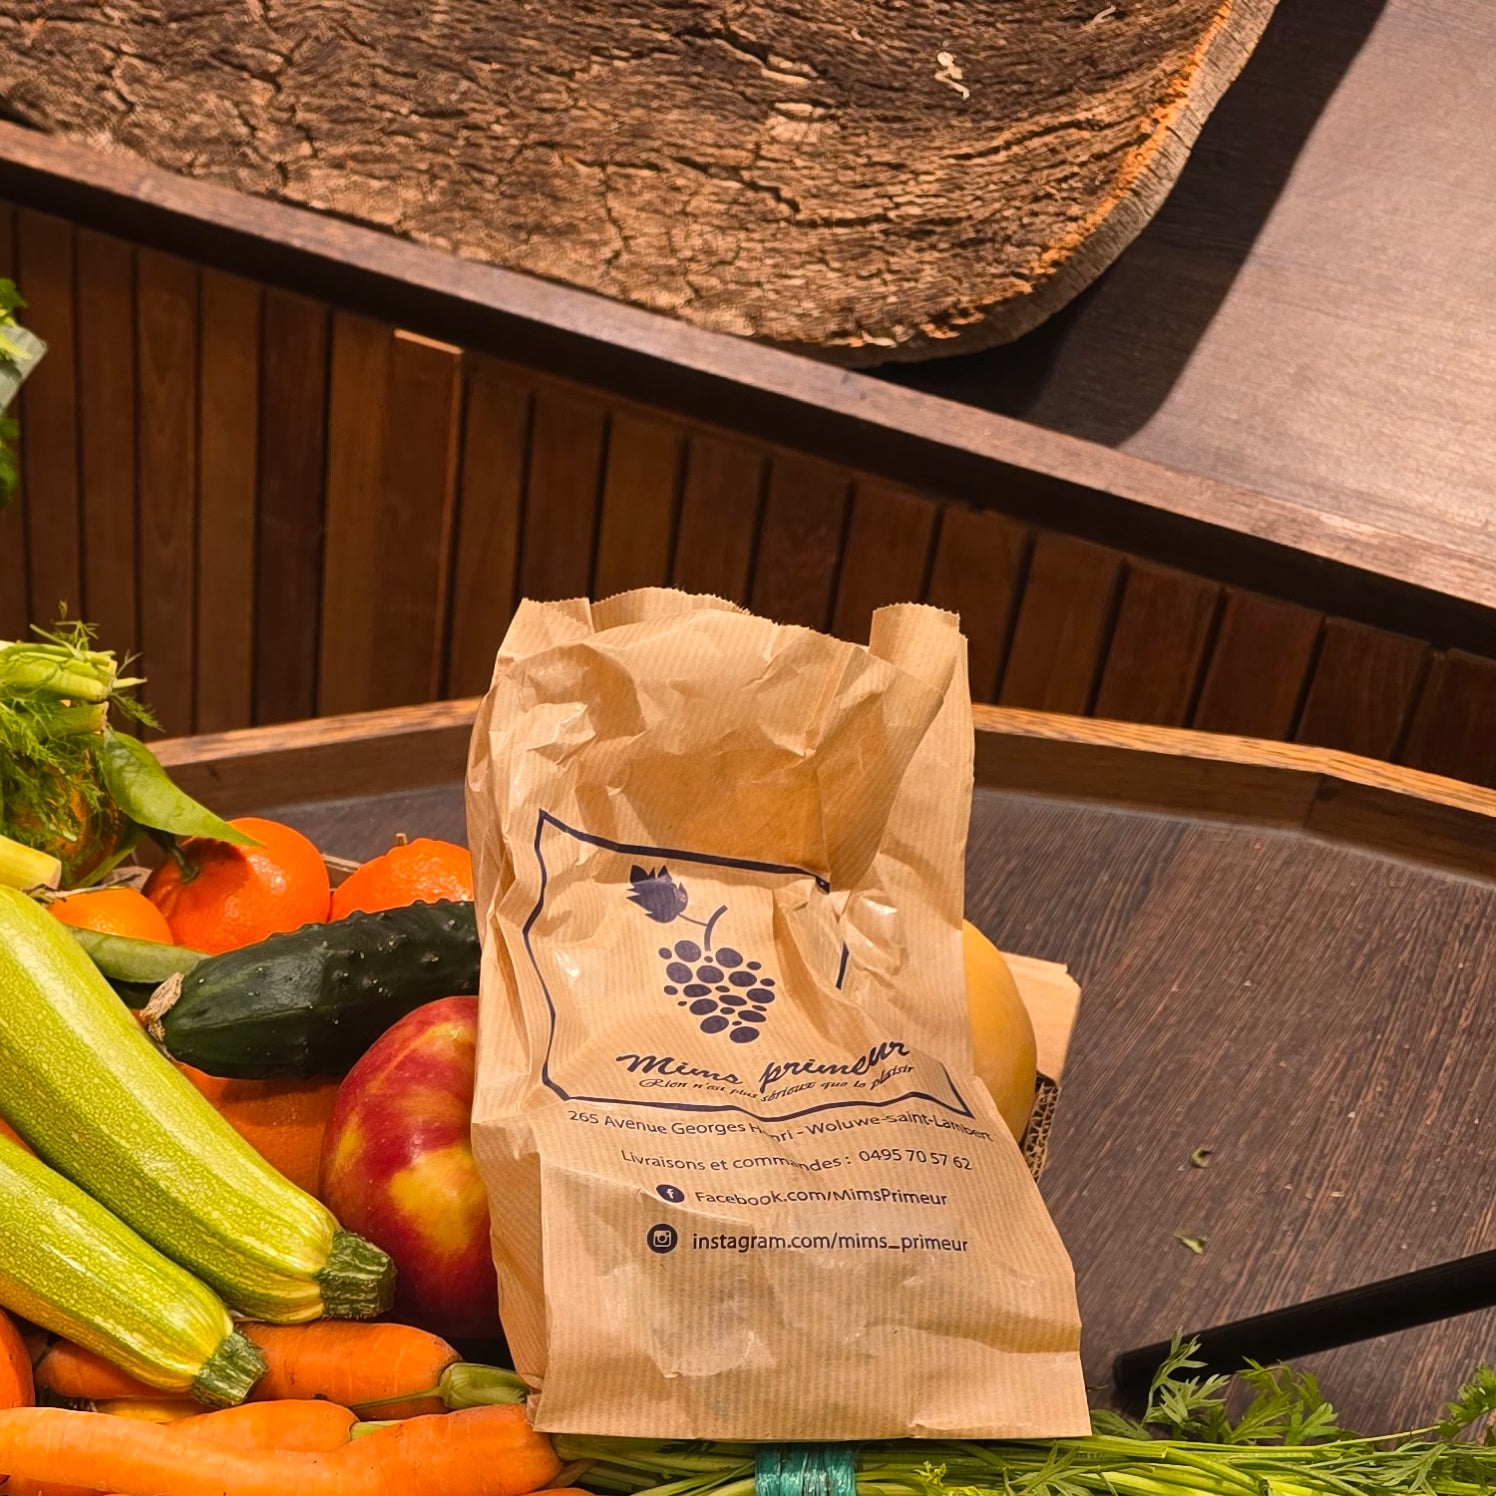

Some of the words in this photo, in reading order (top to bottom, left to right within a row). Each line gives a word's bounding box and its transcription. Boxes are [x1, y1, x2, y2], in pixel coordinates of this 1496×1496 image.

[616, 1054, 743, 1085] Mims
[760, 1041, 910, 1094] primeur
[639, 1078, 688, 1089] Rien
[729, 1088, 758, 1099] plus
[821, 1080, 848, 1089] que
[870, 1065, 915, 1090] plaisir
[568, 1110, 599, 1123] 265
[604, 1116, 667, 1134] Avenue
[671, 1122, 746, 1135] Georges
[749, 1122, 794, 1143] Hnri
[805, 1111, 993, 1142] Woluwe-Saint-Lambert
[621, 1149, 705, 1171] Livraisons
[710, 1159, 728, 1171] et
[733, 1155, 842, 1172] commandes
[858, 1148, 902, 1162] 0495
[905, 1149, 927, 1163] 70
[930, 1152, 948, 1166] 57
[953, 1156, 972, 1170] 62
[695, 1188, 947, 1206] Facebook.com/MimsPrimeur
[692, 1232, 968, 1253] instagram.com/mims_primeur
